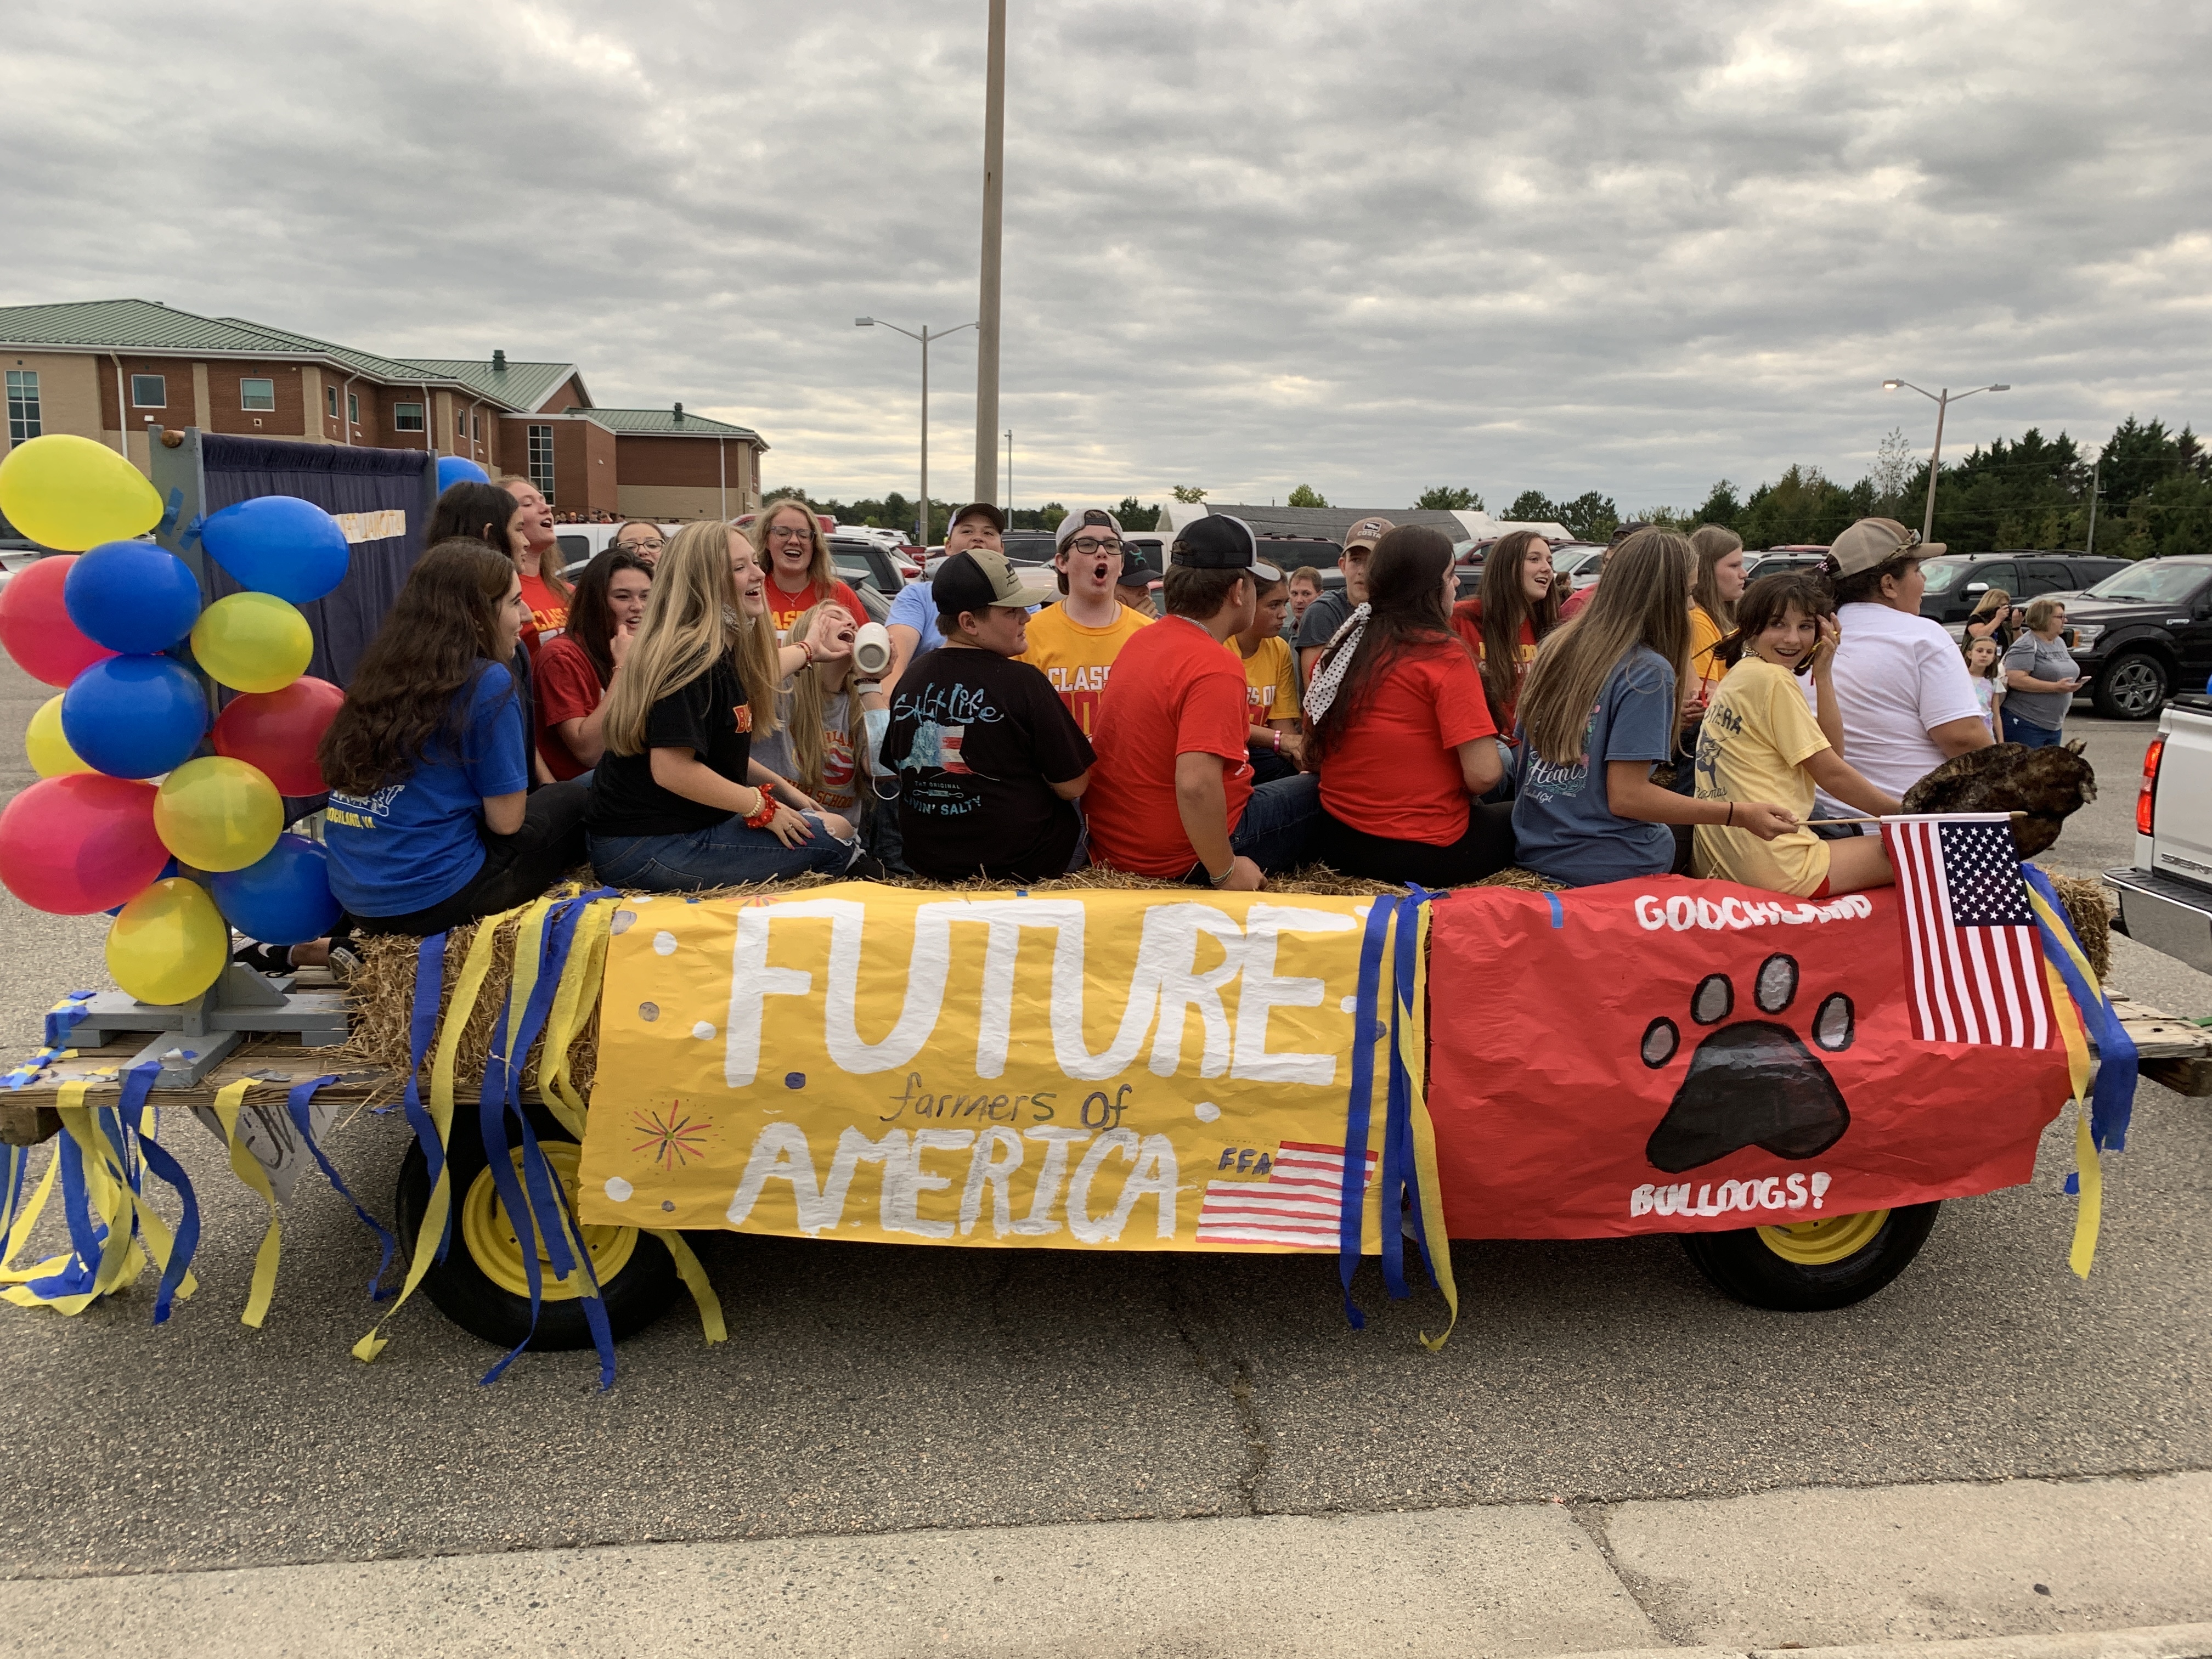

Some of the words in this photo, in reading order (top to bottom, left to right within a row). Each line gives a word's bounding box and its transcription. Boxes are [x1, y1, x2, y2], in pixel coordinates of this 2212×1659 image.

[1357, 531, 1381, 539] COSTA
[904, 794, 936, 814] LIVIN'
[940, 795, 981, 816] SALTY
[1635, 895, 1872, 932] GOOCHLAND
[725, 898, 1357, 1087] FUTURE
[880, 1072, 1057, 1122] farmers
[1218, 1147, 1272, 1175] FFA
[726, 1122, 1178, 1244] AMERICA
[1630, 1172, 1832, 1217] BULLDOGS!
